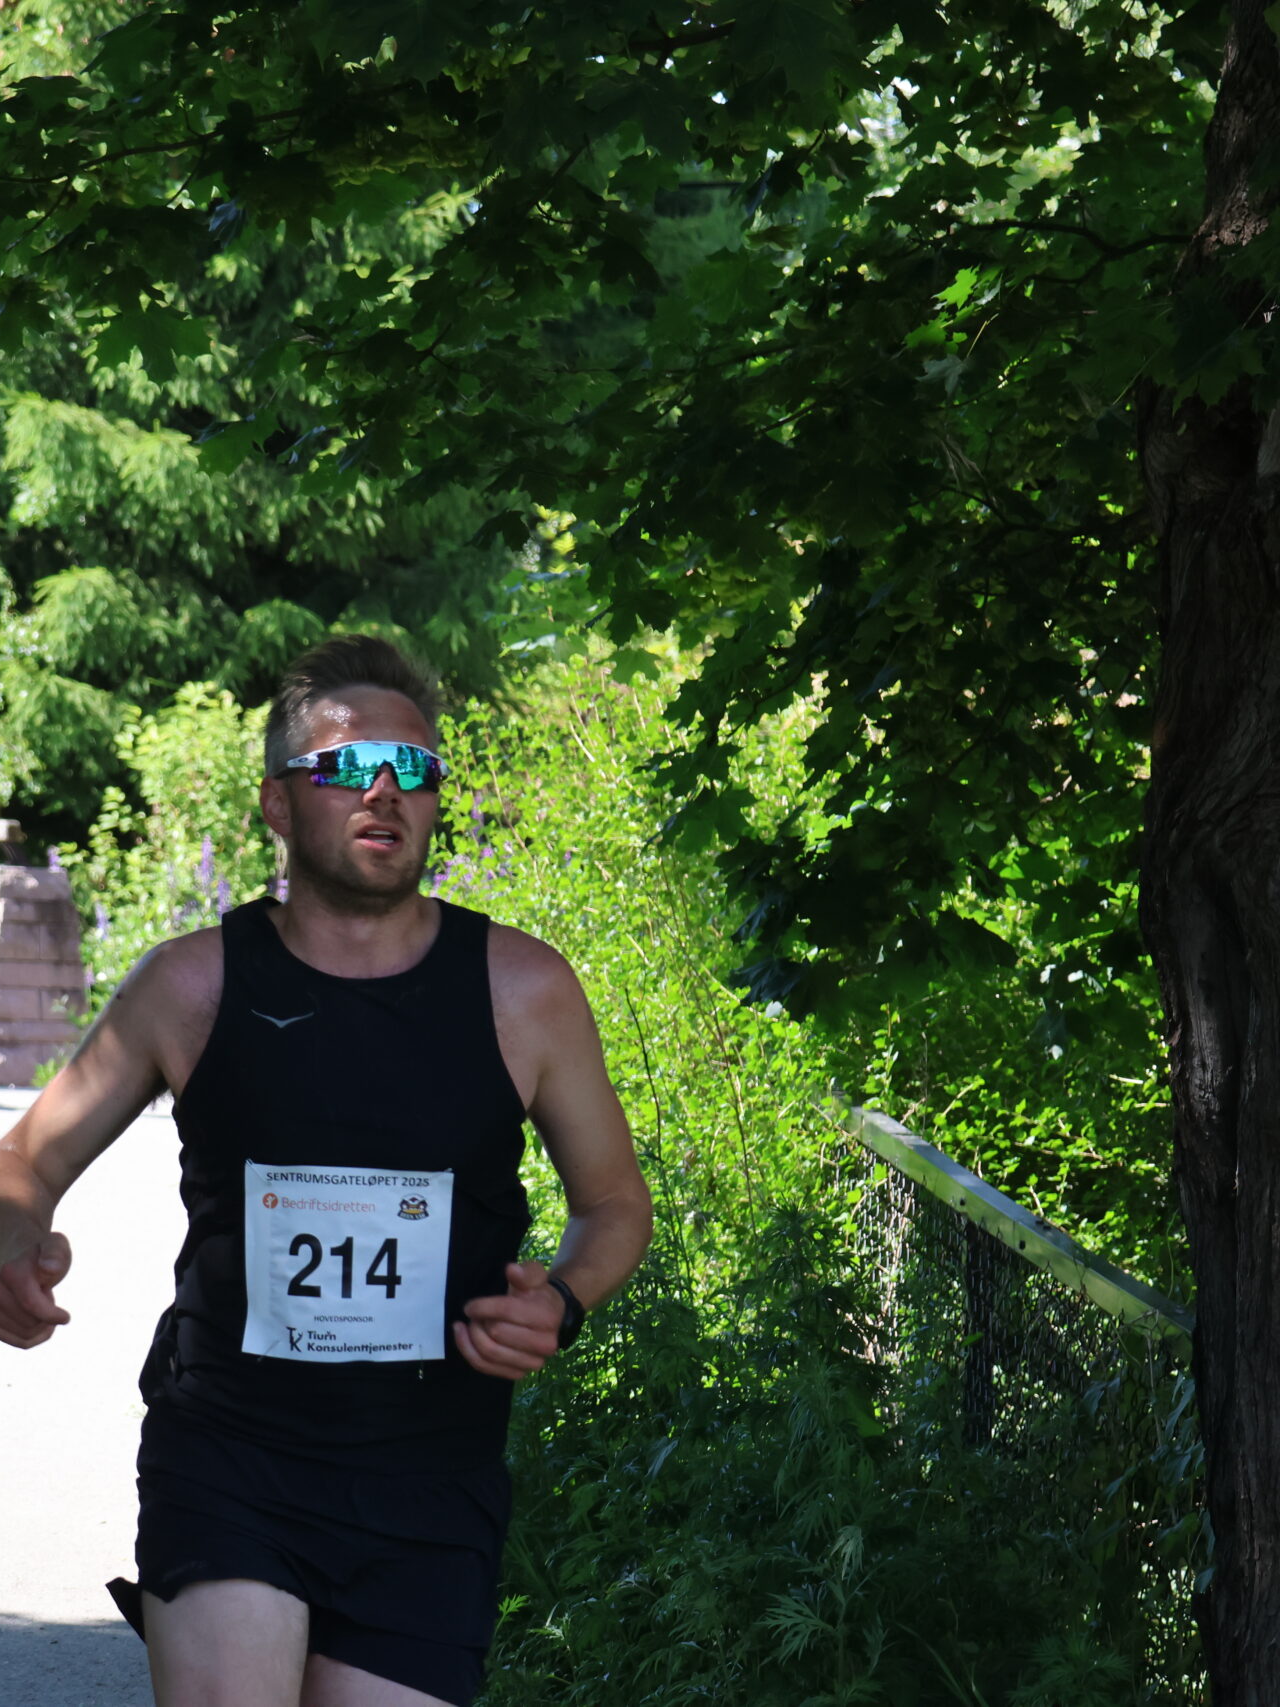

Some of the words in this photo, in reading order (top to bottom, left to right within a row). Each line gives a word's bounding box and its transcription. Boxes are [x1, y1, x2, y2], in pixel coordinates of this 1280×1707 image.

[266, 1171, 399, 1188] SENTRUMSGATELØPET
[401, 1177, 430, 1187] 2025
[281, 1196, 376, 1213] Bedriftsidretten
[286, 1232, 402, 1299] 214
[307, 1342, 414, 1355] Konsulenttjenester
